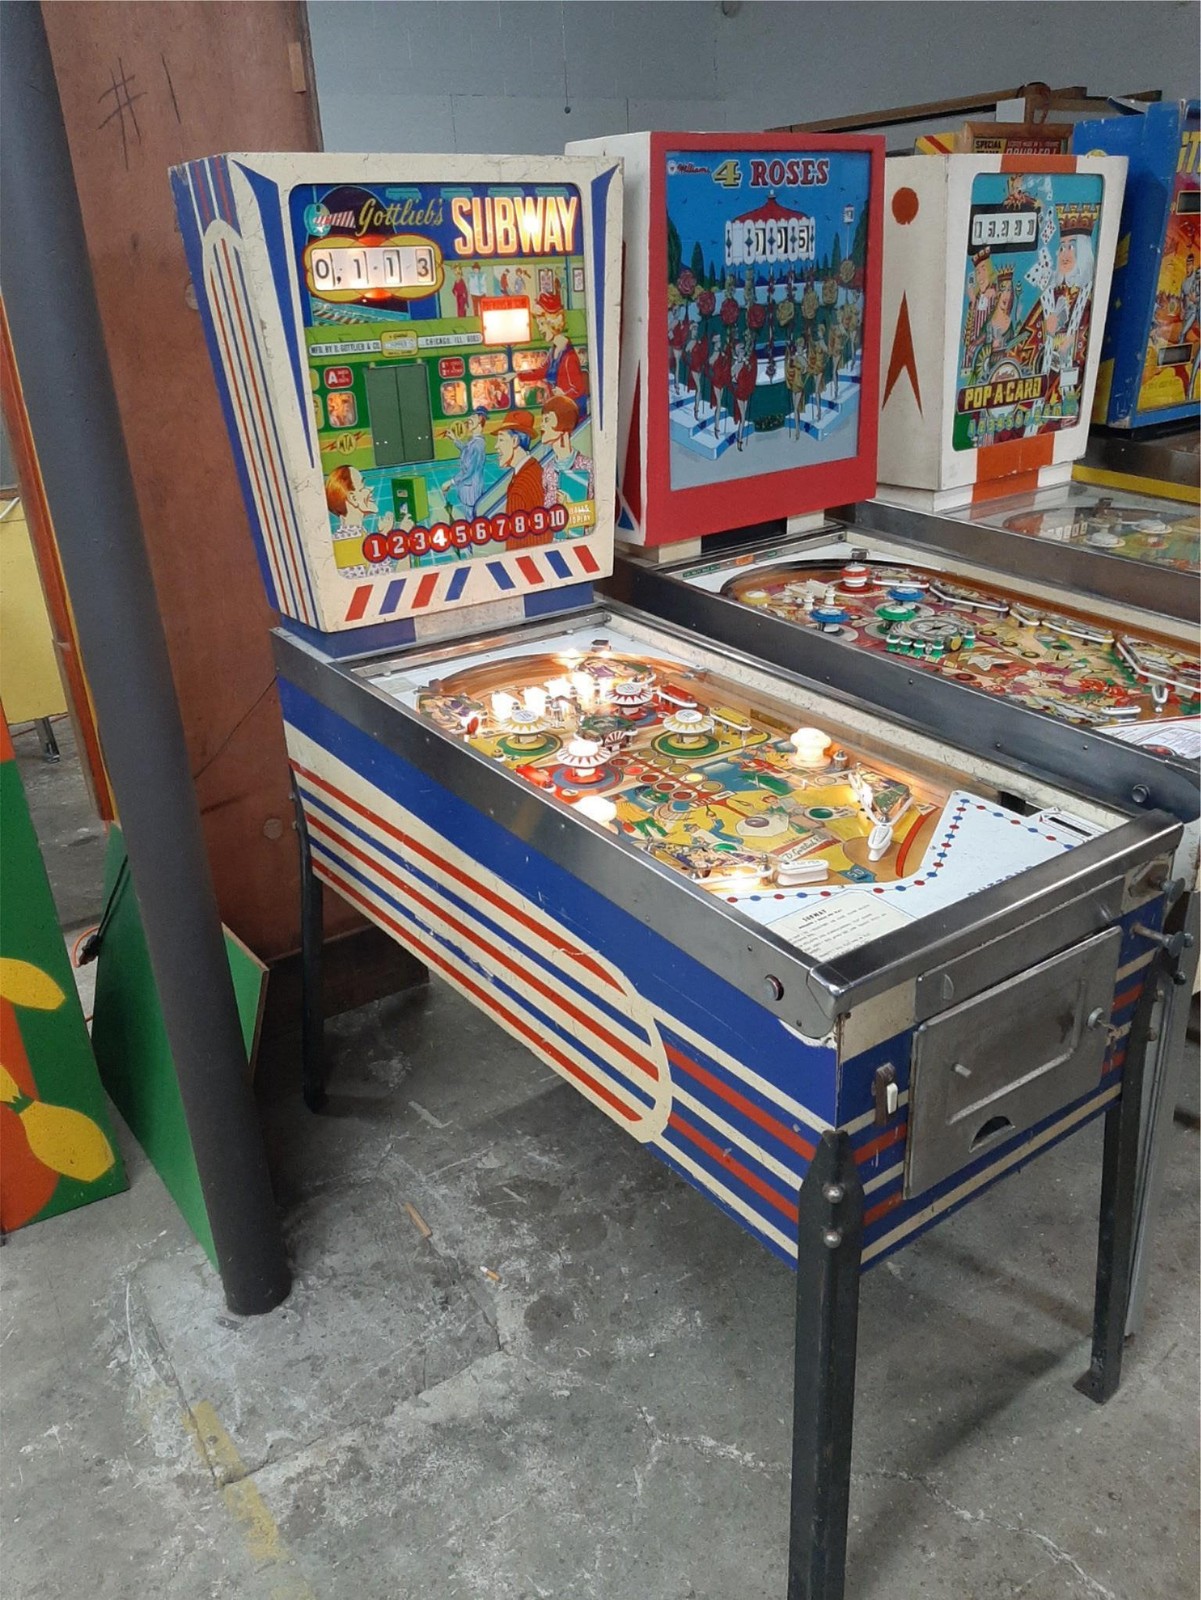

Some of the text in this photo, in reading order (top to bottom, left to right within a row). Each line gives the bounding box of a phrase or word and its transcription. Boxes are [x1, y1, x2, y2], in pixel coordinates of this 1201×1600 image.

[975, 140, 1001, 149] SPECIAL
[714, 161, 741, 187] 4
[750, 160, 829, 186] ROSES
[355, 196, 577, 256] Gottlieb's SUBWAY
[341, 343, 364, 352] GOTTLIEB
[328, 371, 338, 384] A
[339, 434, 353, 452] MTA
[372, 509, 565, 557] 1 2 3 4 5 6 7 8 9 10
